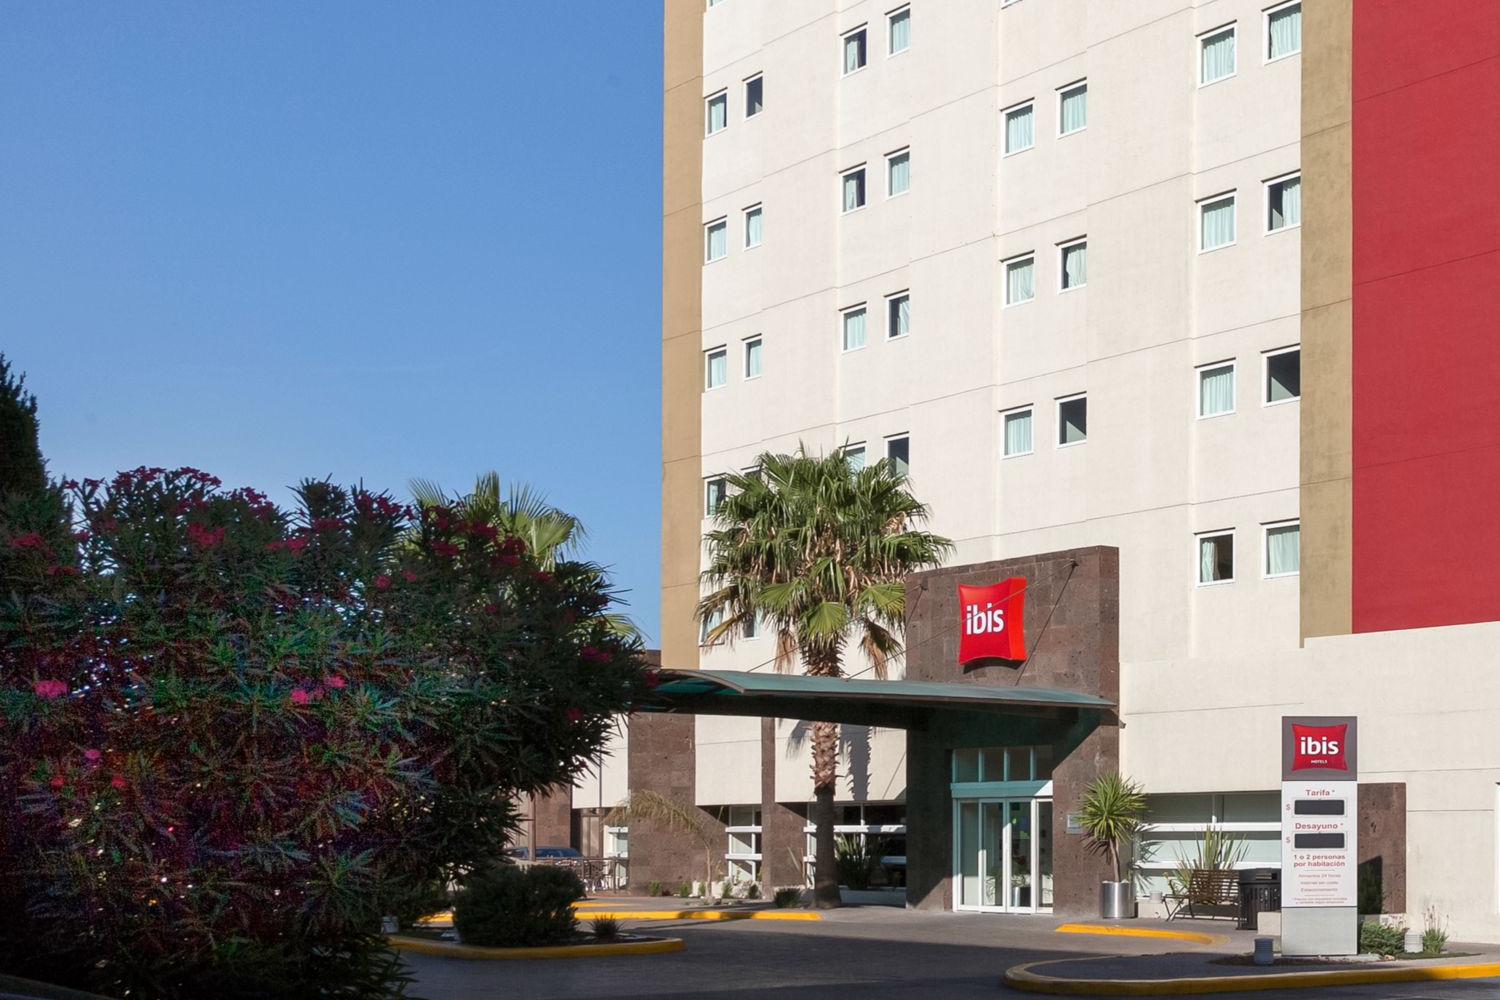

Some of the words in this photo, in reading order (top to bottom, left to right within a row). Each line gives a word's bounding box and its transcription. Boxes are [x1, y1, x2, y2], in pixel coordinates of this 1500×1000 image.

[966, 602, 1004, 635] ibis
[1300, 736, 1339, 755] ibis
[1295, 822, 1339, 831] Desayuno
